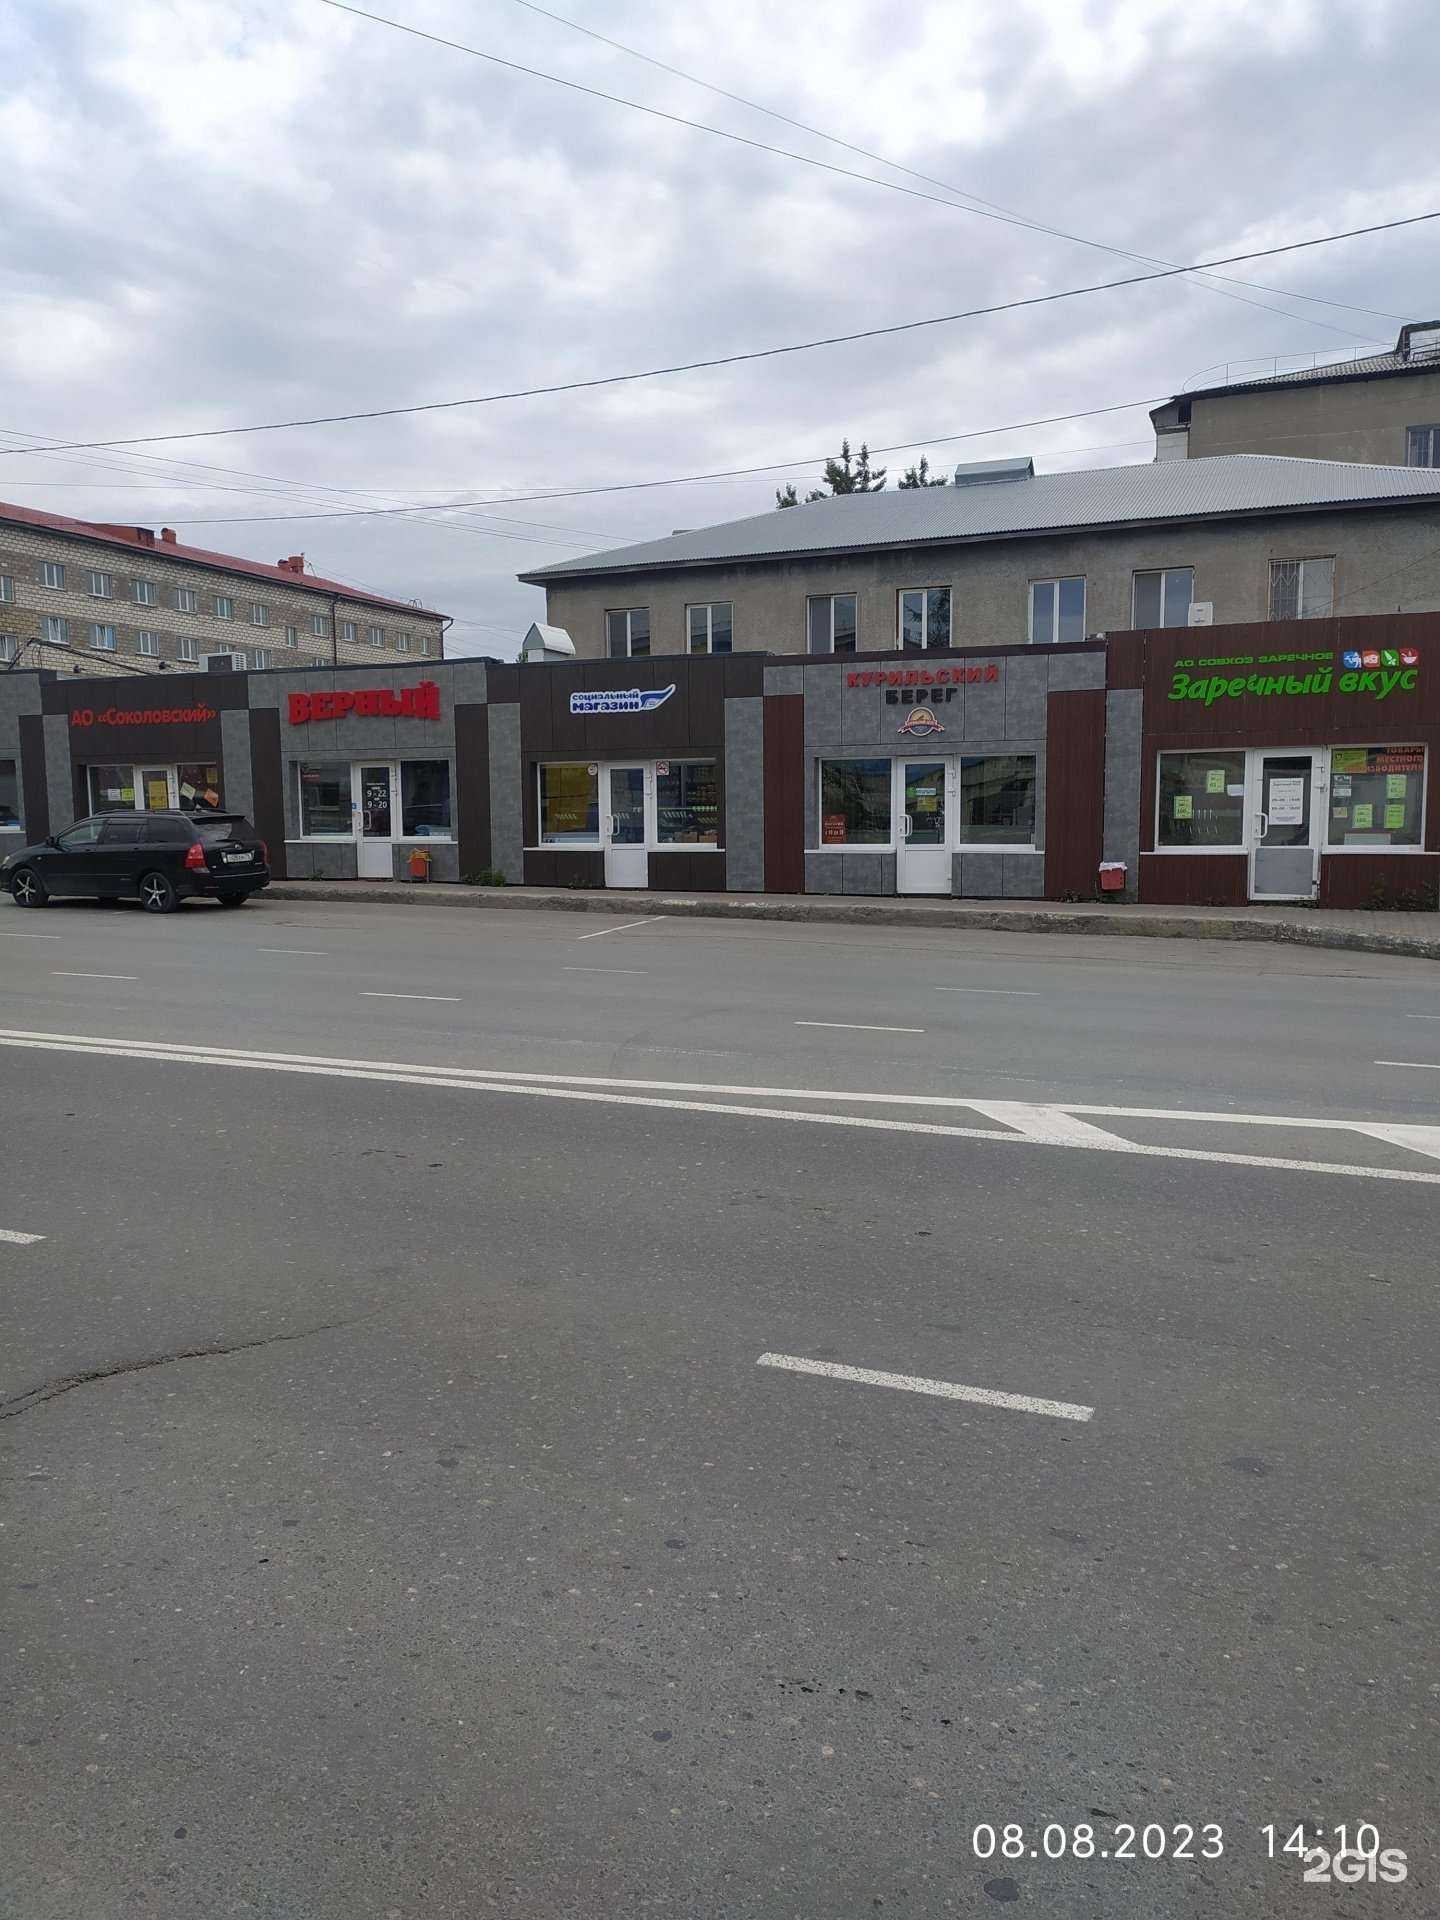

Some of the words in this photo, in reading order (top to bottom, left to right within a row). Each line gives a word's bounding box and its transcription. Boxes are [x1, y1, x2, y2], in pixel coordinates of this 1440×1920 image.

[1174, 659, 1194, 668] АО
[1198, 656, 1254, 666] СОВХОЗ
[1258, 652, 1336, 664] ЗАРЕЧНОЕ
[847, 664, 999, 687] КУРИЛЬСКИЙ
[572, 690, 639, 701] социальный
[1168, 667, 1332, 706] Заречный
[1338, 669, 1418, 699] вкус
[287, 680, 440, 725] ВЕРНЫЙ
[885, 687, 958, 705] БЕРЕГ
[72, 709, 93, 726] АО
[97, 703, 217, 725] «Соколовский»
[572, 701, 639, 711] магазин
[377, 800, 388, 809] 20
